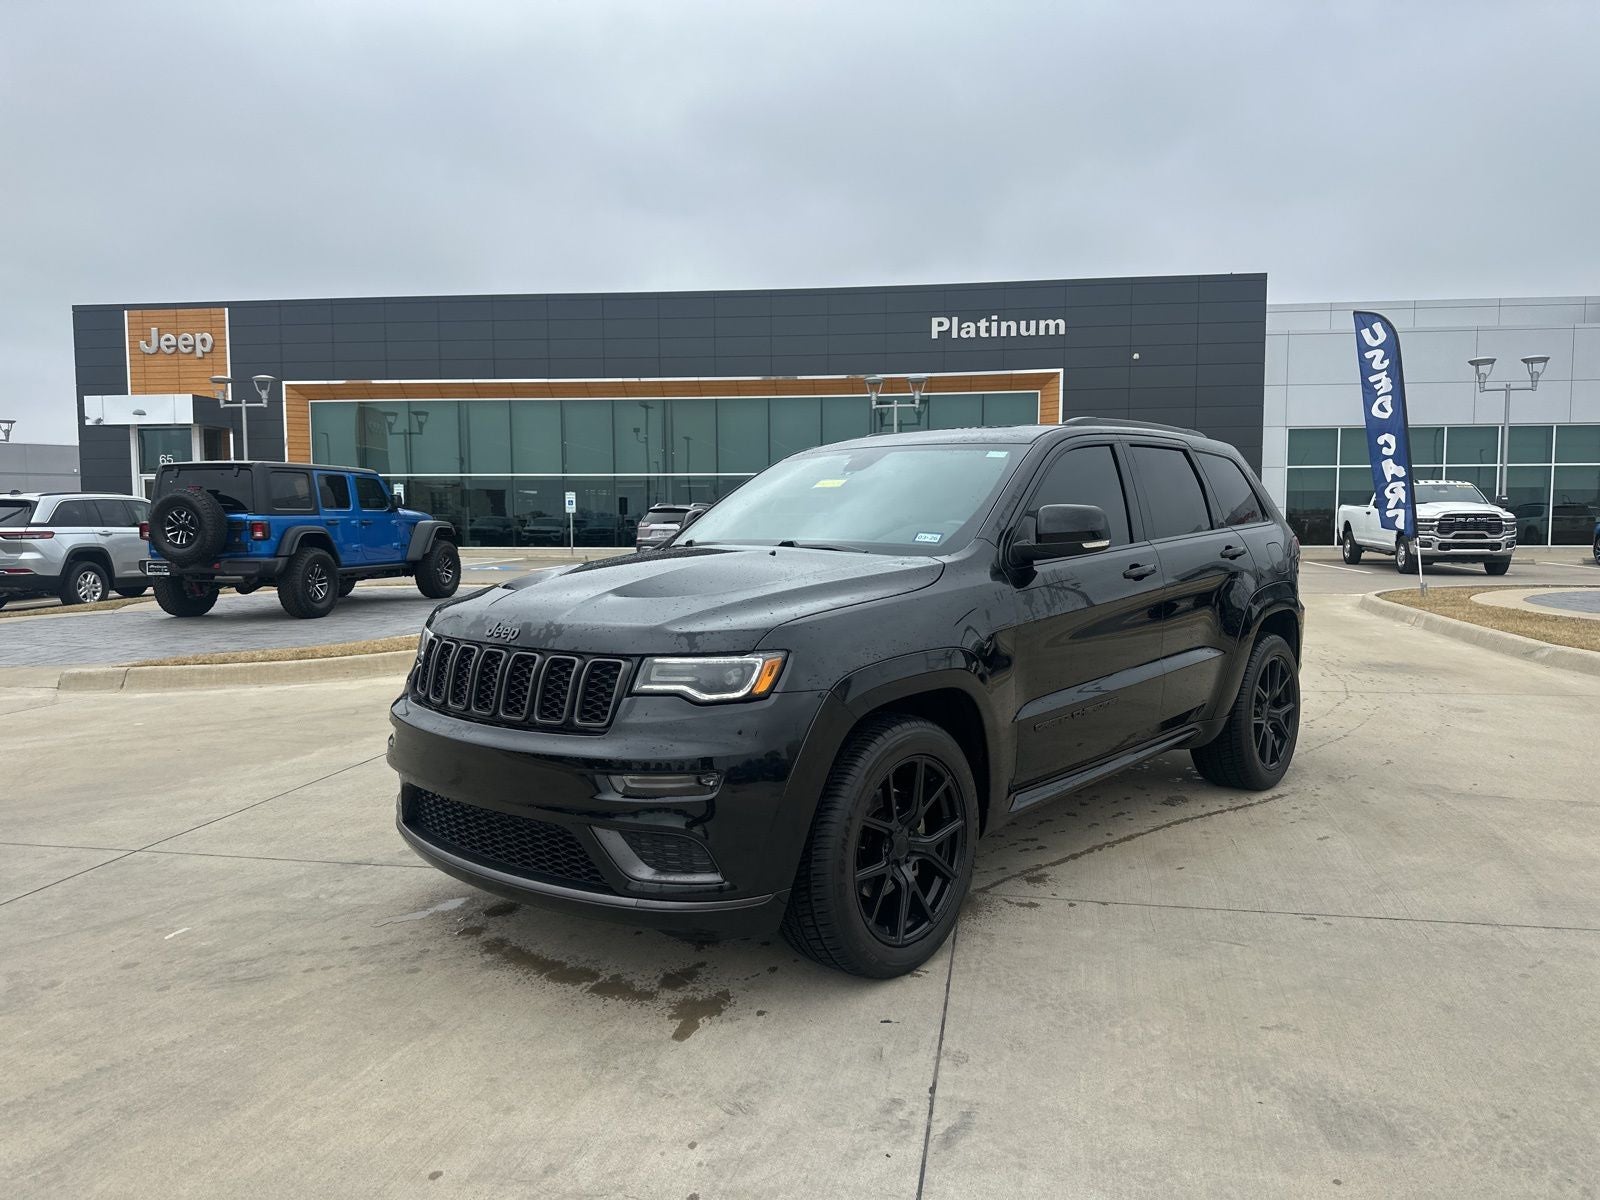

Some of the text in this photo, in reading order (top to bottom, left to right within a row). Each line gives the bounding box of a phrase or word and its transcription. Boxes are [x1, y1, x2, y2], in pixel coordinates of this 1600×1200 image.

[931, 315, 1066, 339] Platinum
[139, 327, 214, 359] Jeep
[159, 454, 174, 465] 65
[485, 621, 520, 643] Jeep
